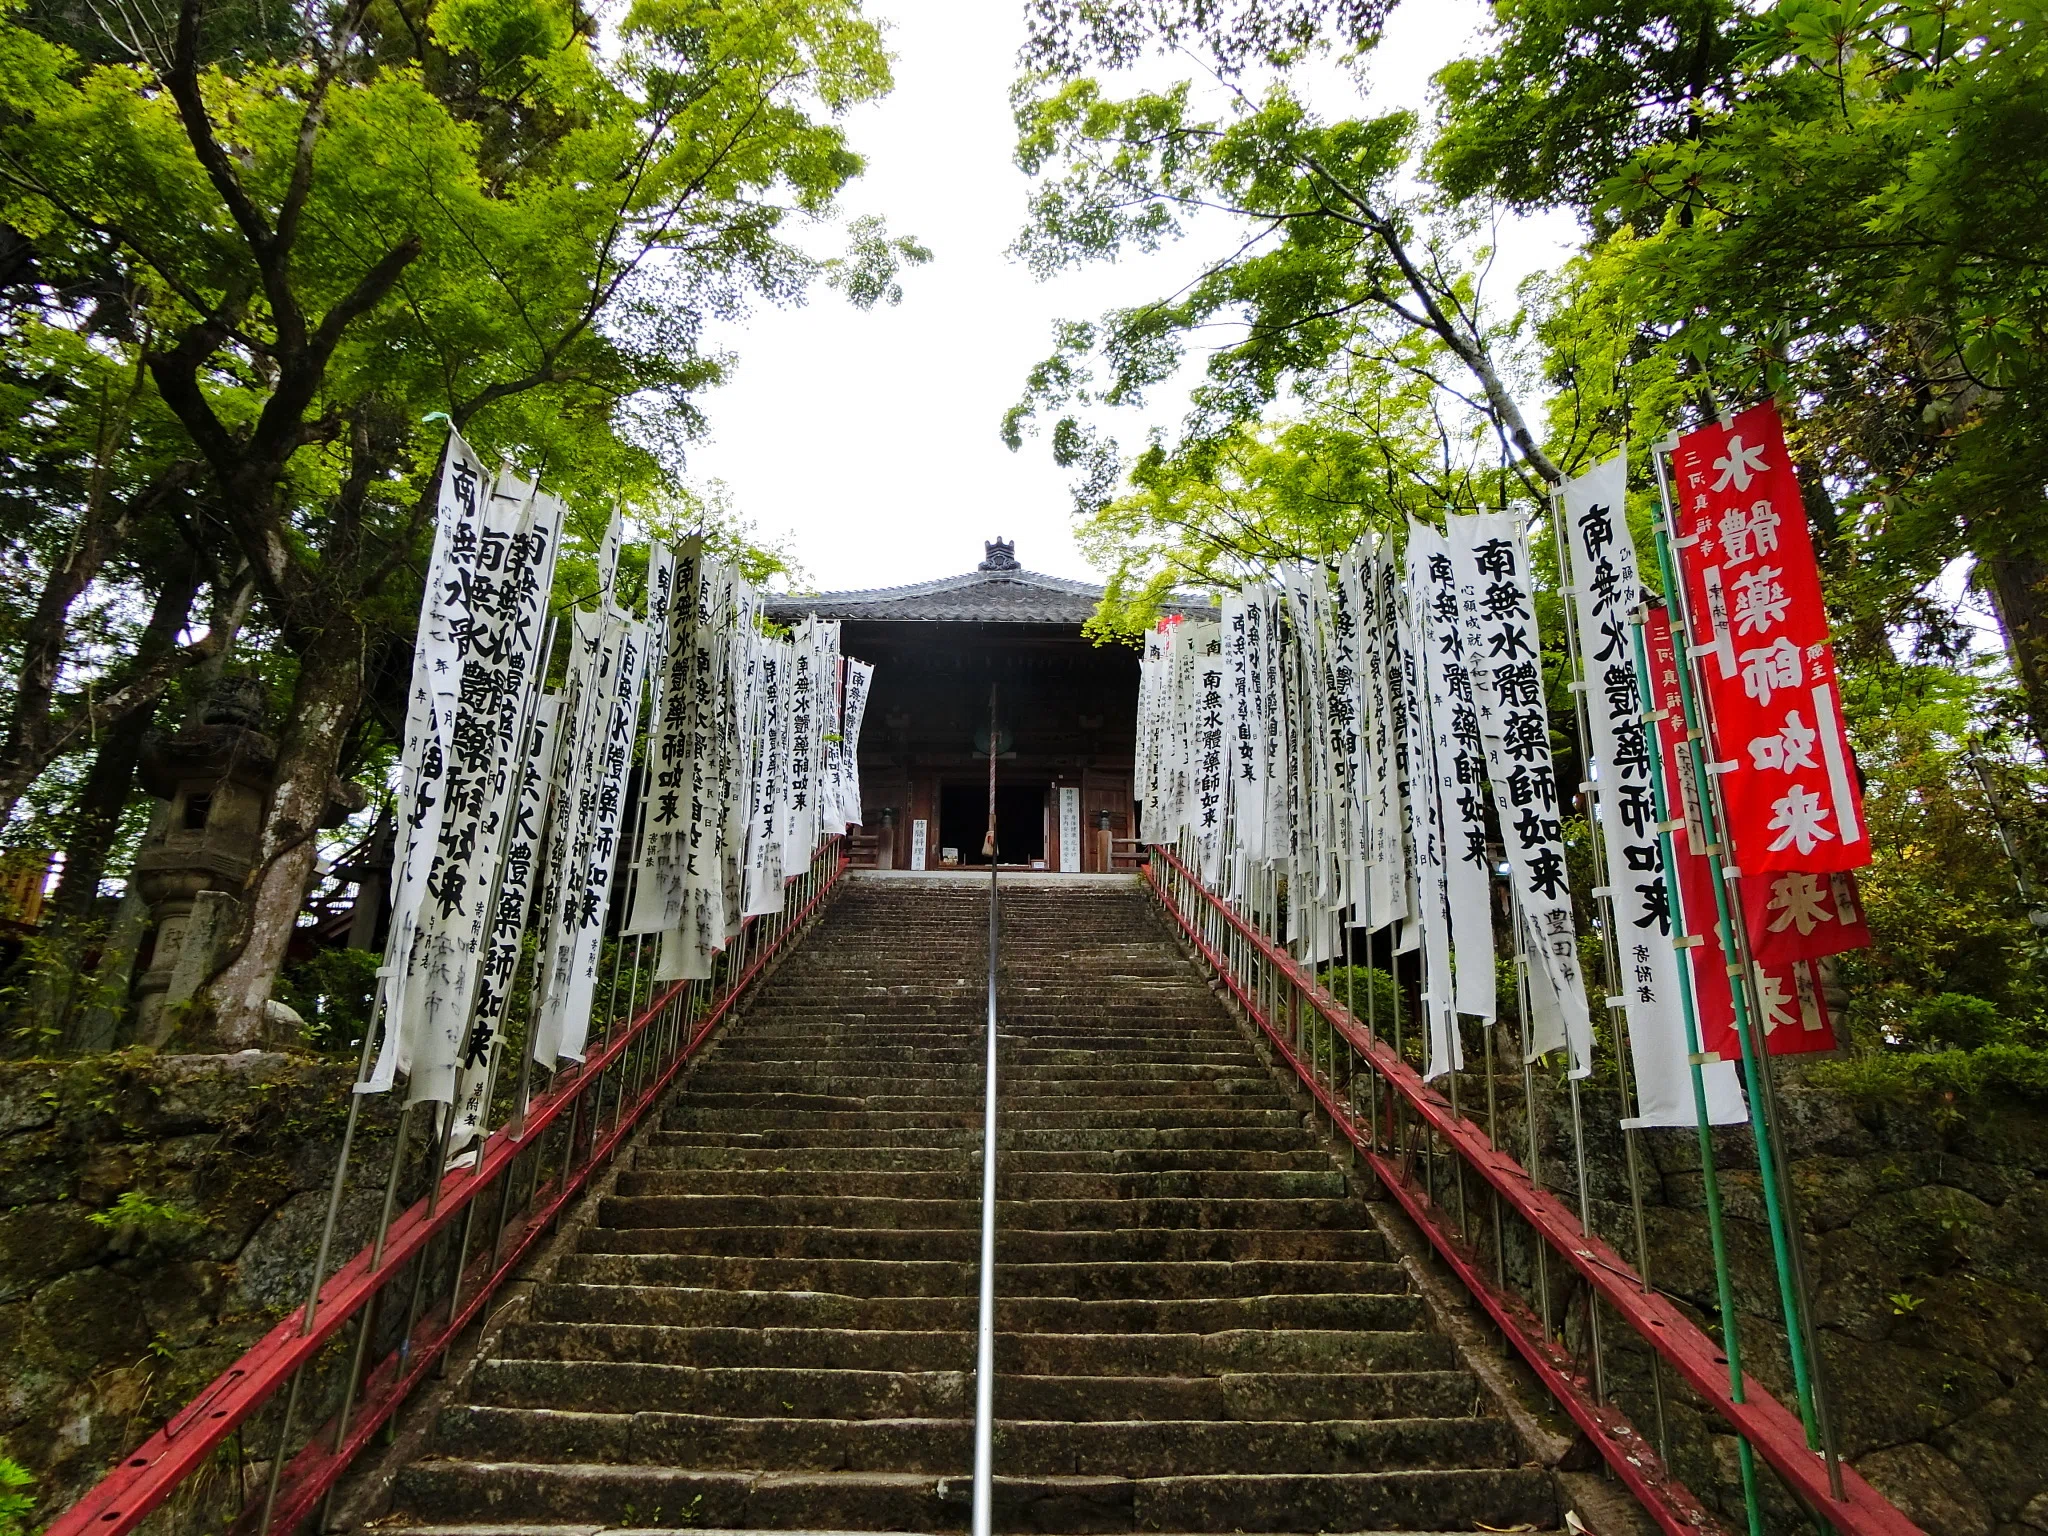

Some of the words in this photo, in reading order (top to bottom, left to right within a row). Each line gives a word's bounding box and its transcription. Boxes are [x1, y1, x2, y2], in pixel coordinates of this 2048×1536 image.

[1433, 694, 1443, 707] 年
[1472, 538, 1570, 901] 南無水體藥師如来
[1439, 734, 1448, 748] 月
[1200, 669, 1223, 828] 南無水體藥師如来
[1443, 776, 1452, 789] 日
